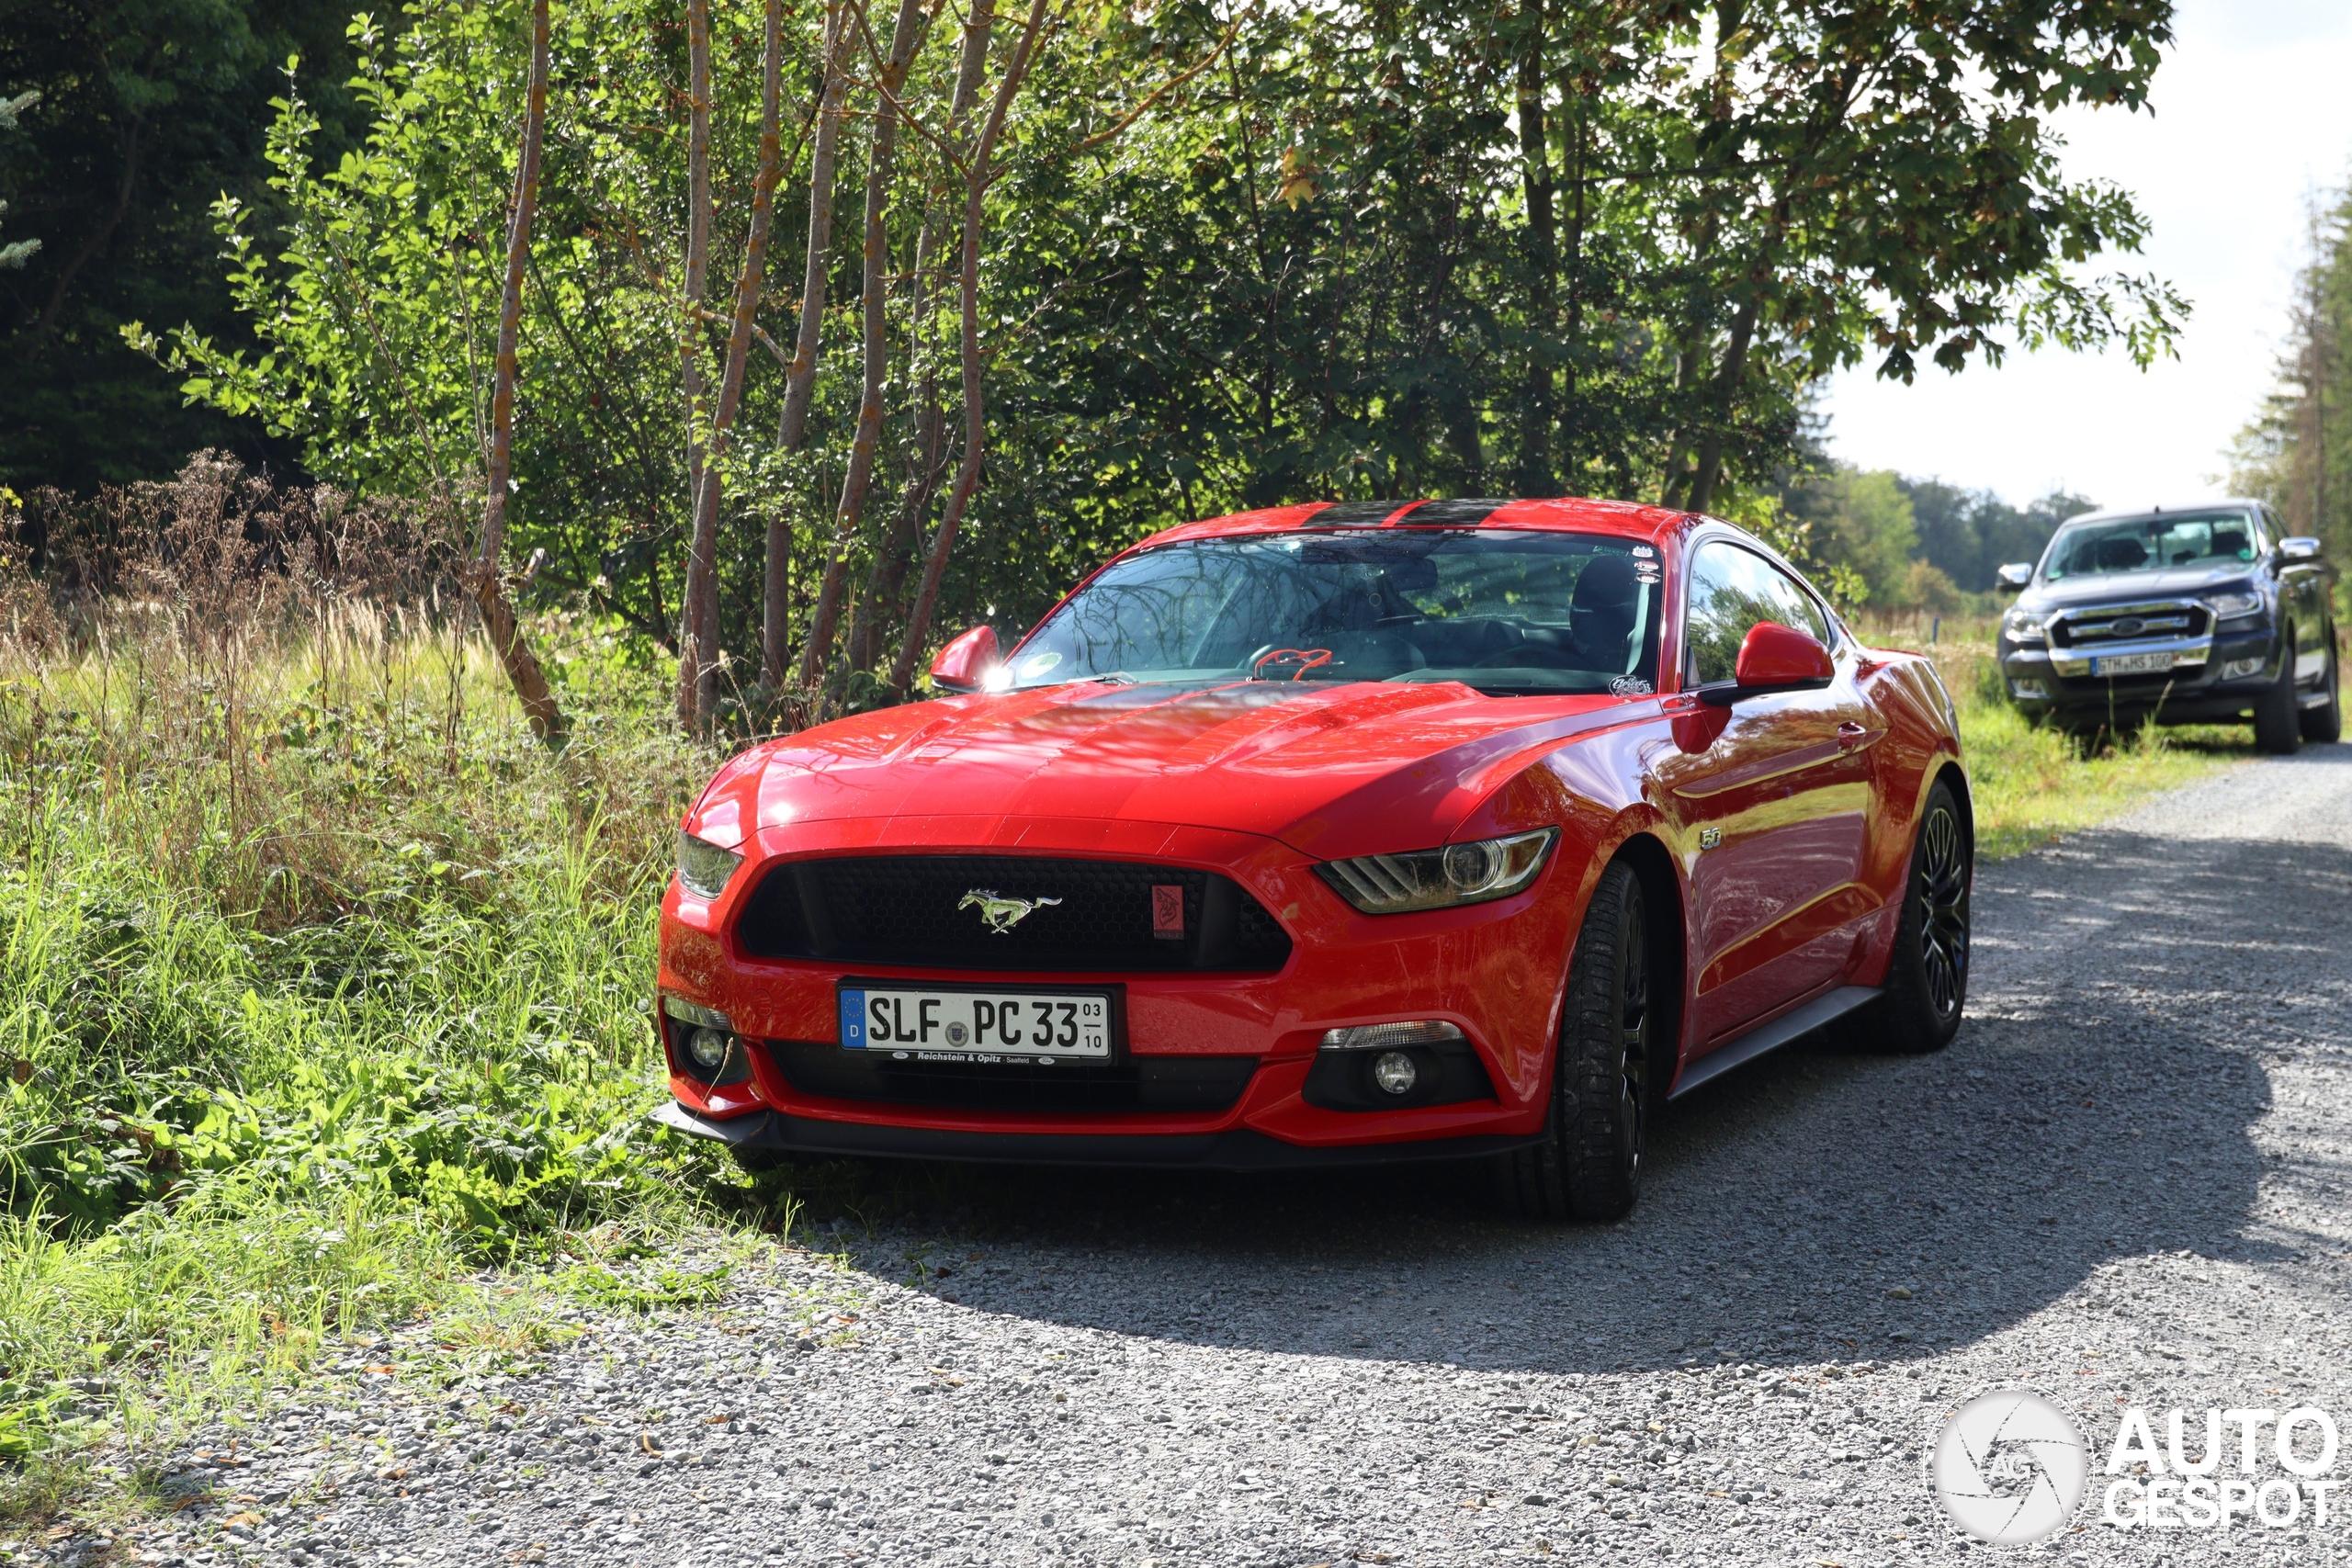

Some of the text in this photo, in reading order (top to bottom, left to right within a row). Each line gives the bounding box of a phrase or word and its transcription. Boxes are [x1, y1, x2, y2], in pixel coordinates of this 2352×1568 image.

[2098, 658, 2121, 671] GTH
[2130, 655, 2145, 670] HS
[1082, 1003, 1101, 1016] 03
[869, 998, 941, 1043] SLF
[973, 999, 1022, 1045] PC
[1032, 1001, 1079, 1047] 33
[850, 1024, 859, 1038] D
[1084, 1034, 1102, 1048] 10
[917, 1052, 966, 1062] Reichstein
[967, 1054, 975, 1062] &
[978, 1055, 1001, 1064] Opitz
